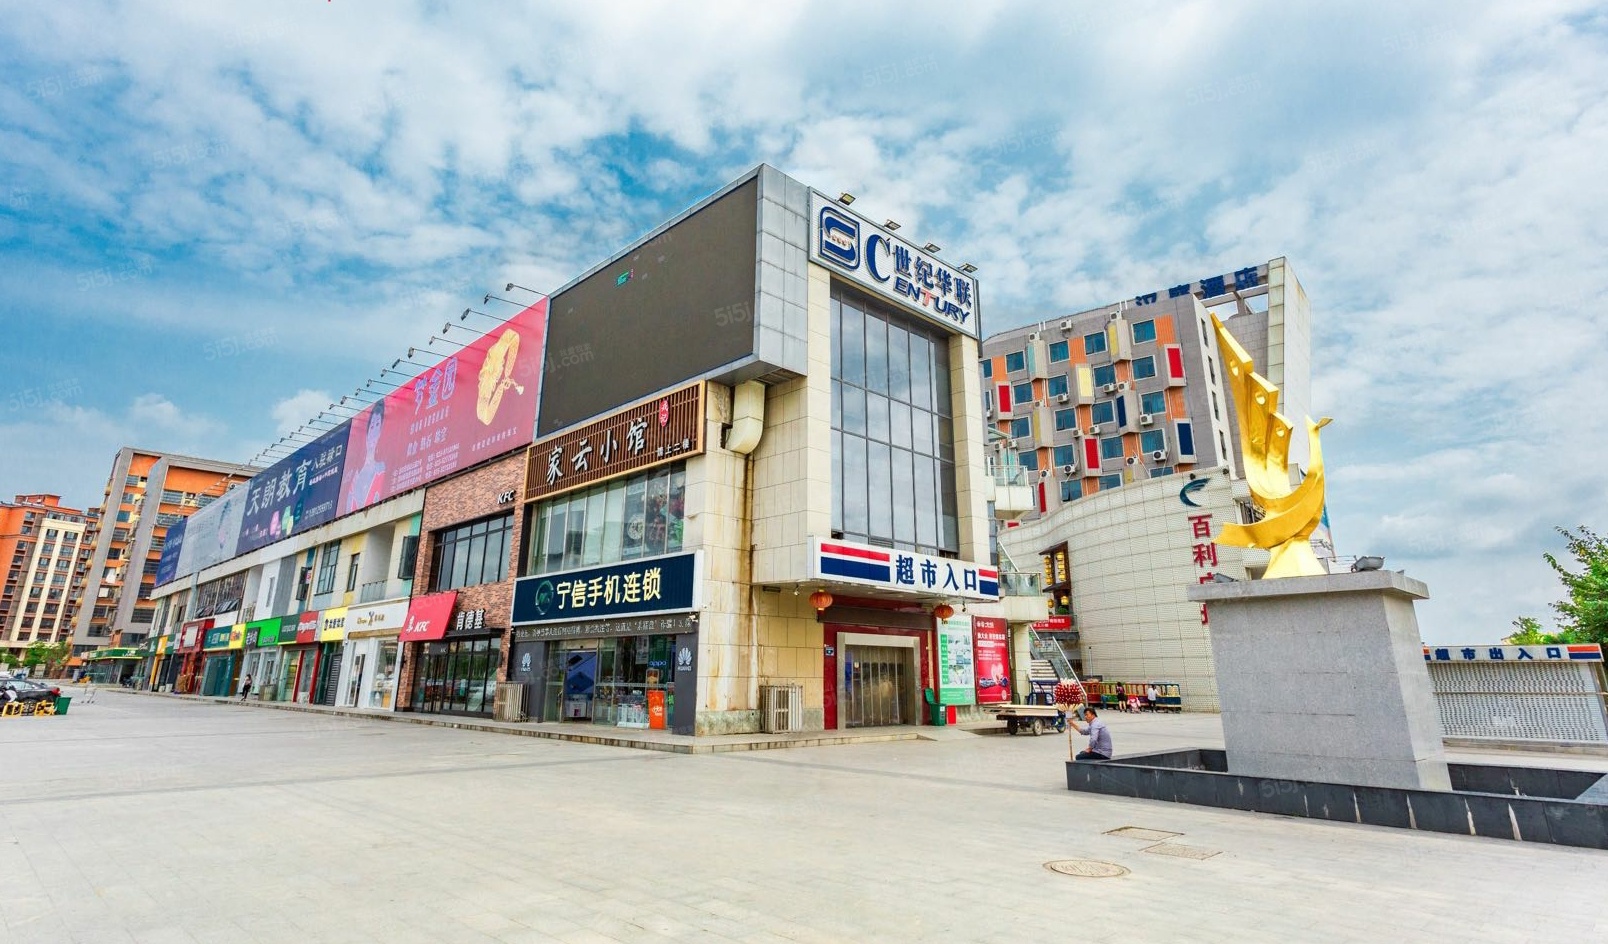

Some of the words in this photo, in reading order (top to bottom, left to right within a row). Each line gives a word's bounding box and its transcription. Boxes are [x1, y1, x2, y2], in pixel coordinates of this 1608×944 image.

[893, 244, 972, 309] 世纪华联
[547, 417, 648, 486] 家云小馆
[497, 489, 516, 505] KFC
[556, 567, 662, 610] 宁信手机连锁
[896, 554, 978, 592] 超市入口
[1187, 513, 1218, 626] 百利
[413, 620, 431, 633] KFC
[456, 608, 485, 631] 肯德基
[1435, 646, 1562, 661] 超市出入口
